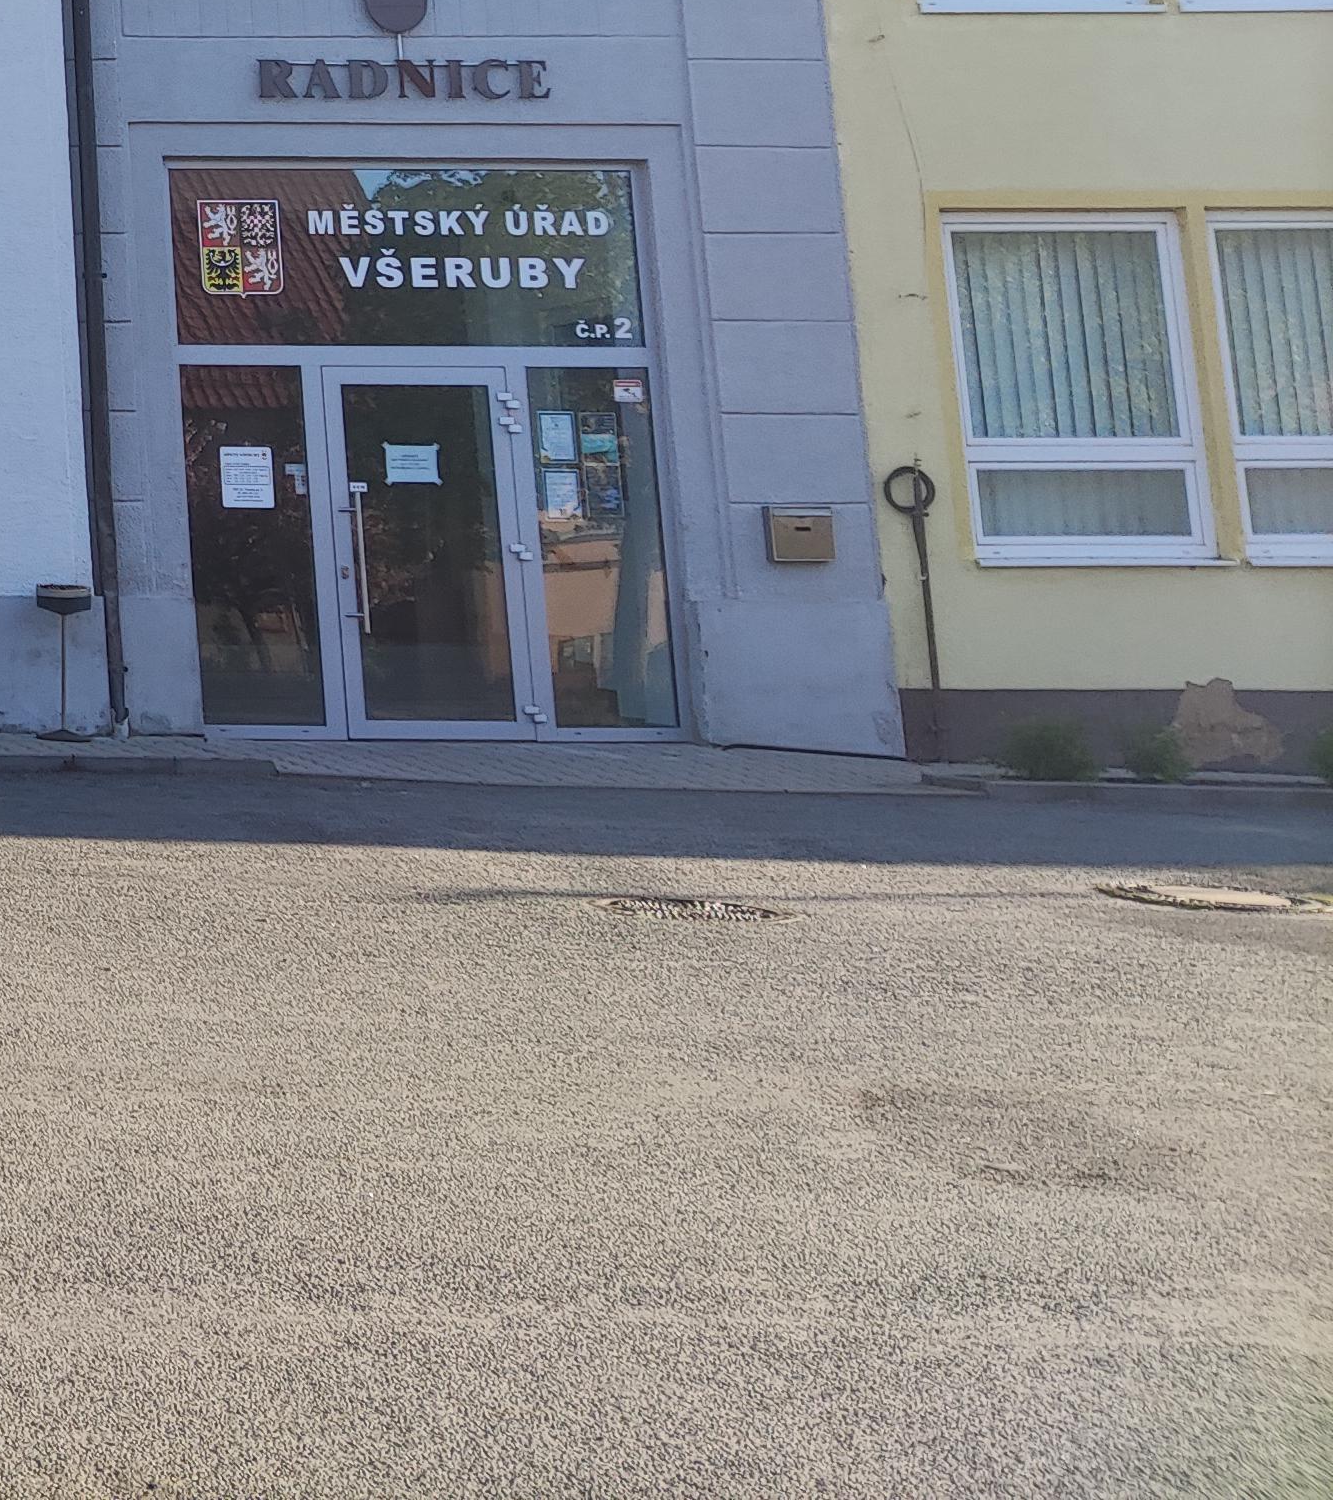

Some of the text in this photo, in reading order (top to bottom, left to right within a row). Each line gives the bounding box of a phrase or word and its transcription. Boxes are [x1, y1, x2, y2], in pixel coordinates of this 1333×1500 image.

[256, 58, 551, 100] RADNICE
[307, 203, 609, 236] MĚSTSKÝ ÚŘAD
[339, 248, 585, 289] VŠERUBY
[575, 317, 633, 339] Č.P. 2
